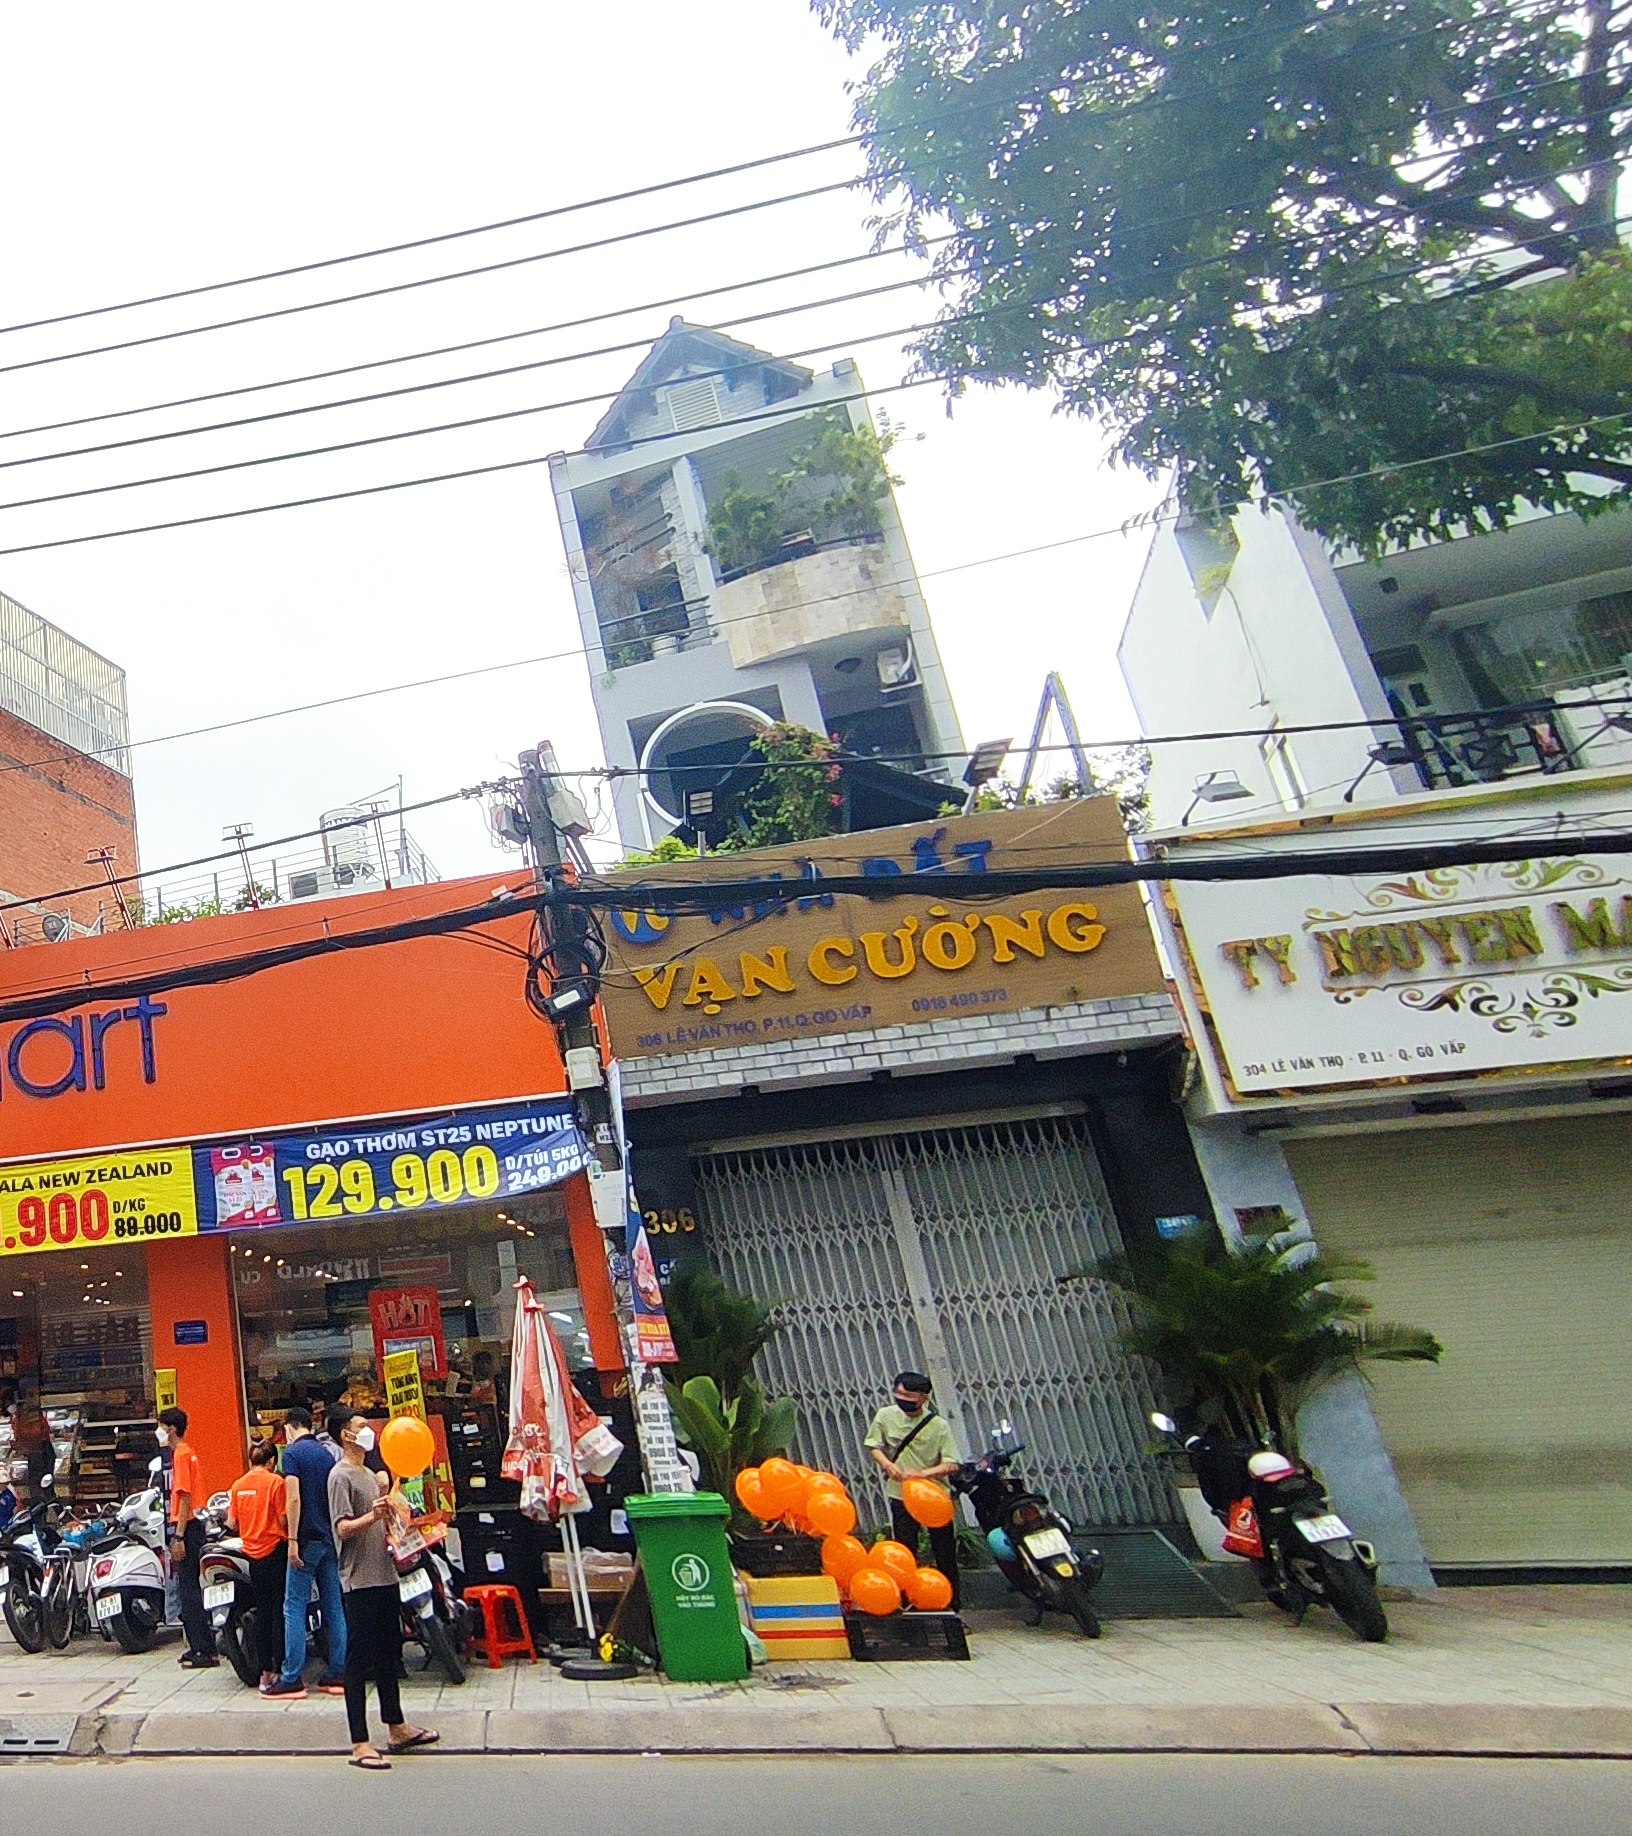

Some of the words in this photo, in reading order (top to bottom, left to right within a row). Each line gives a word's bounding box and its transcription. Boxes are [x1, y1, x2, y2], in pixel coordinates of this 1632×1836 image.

[632, 945, 797, 1016] VẠN
[808, 903, 1108, 986] CƯỜNG
[305, 1140, 350, 1162] GẠO
[352, 1131, 418, 1157] THƠM
[421, 1125, 471, 1149] ST25
[475, 1112, 573, 1143] NEPTUNE
[38, 1170, 81, 1190] NEW
[85, 1161, 174, 1184] ZEALAND
[281, 1144, 501, 1220] 129.900
